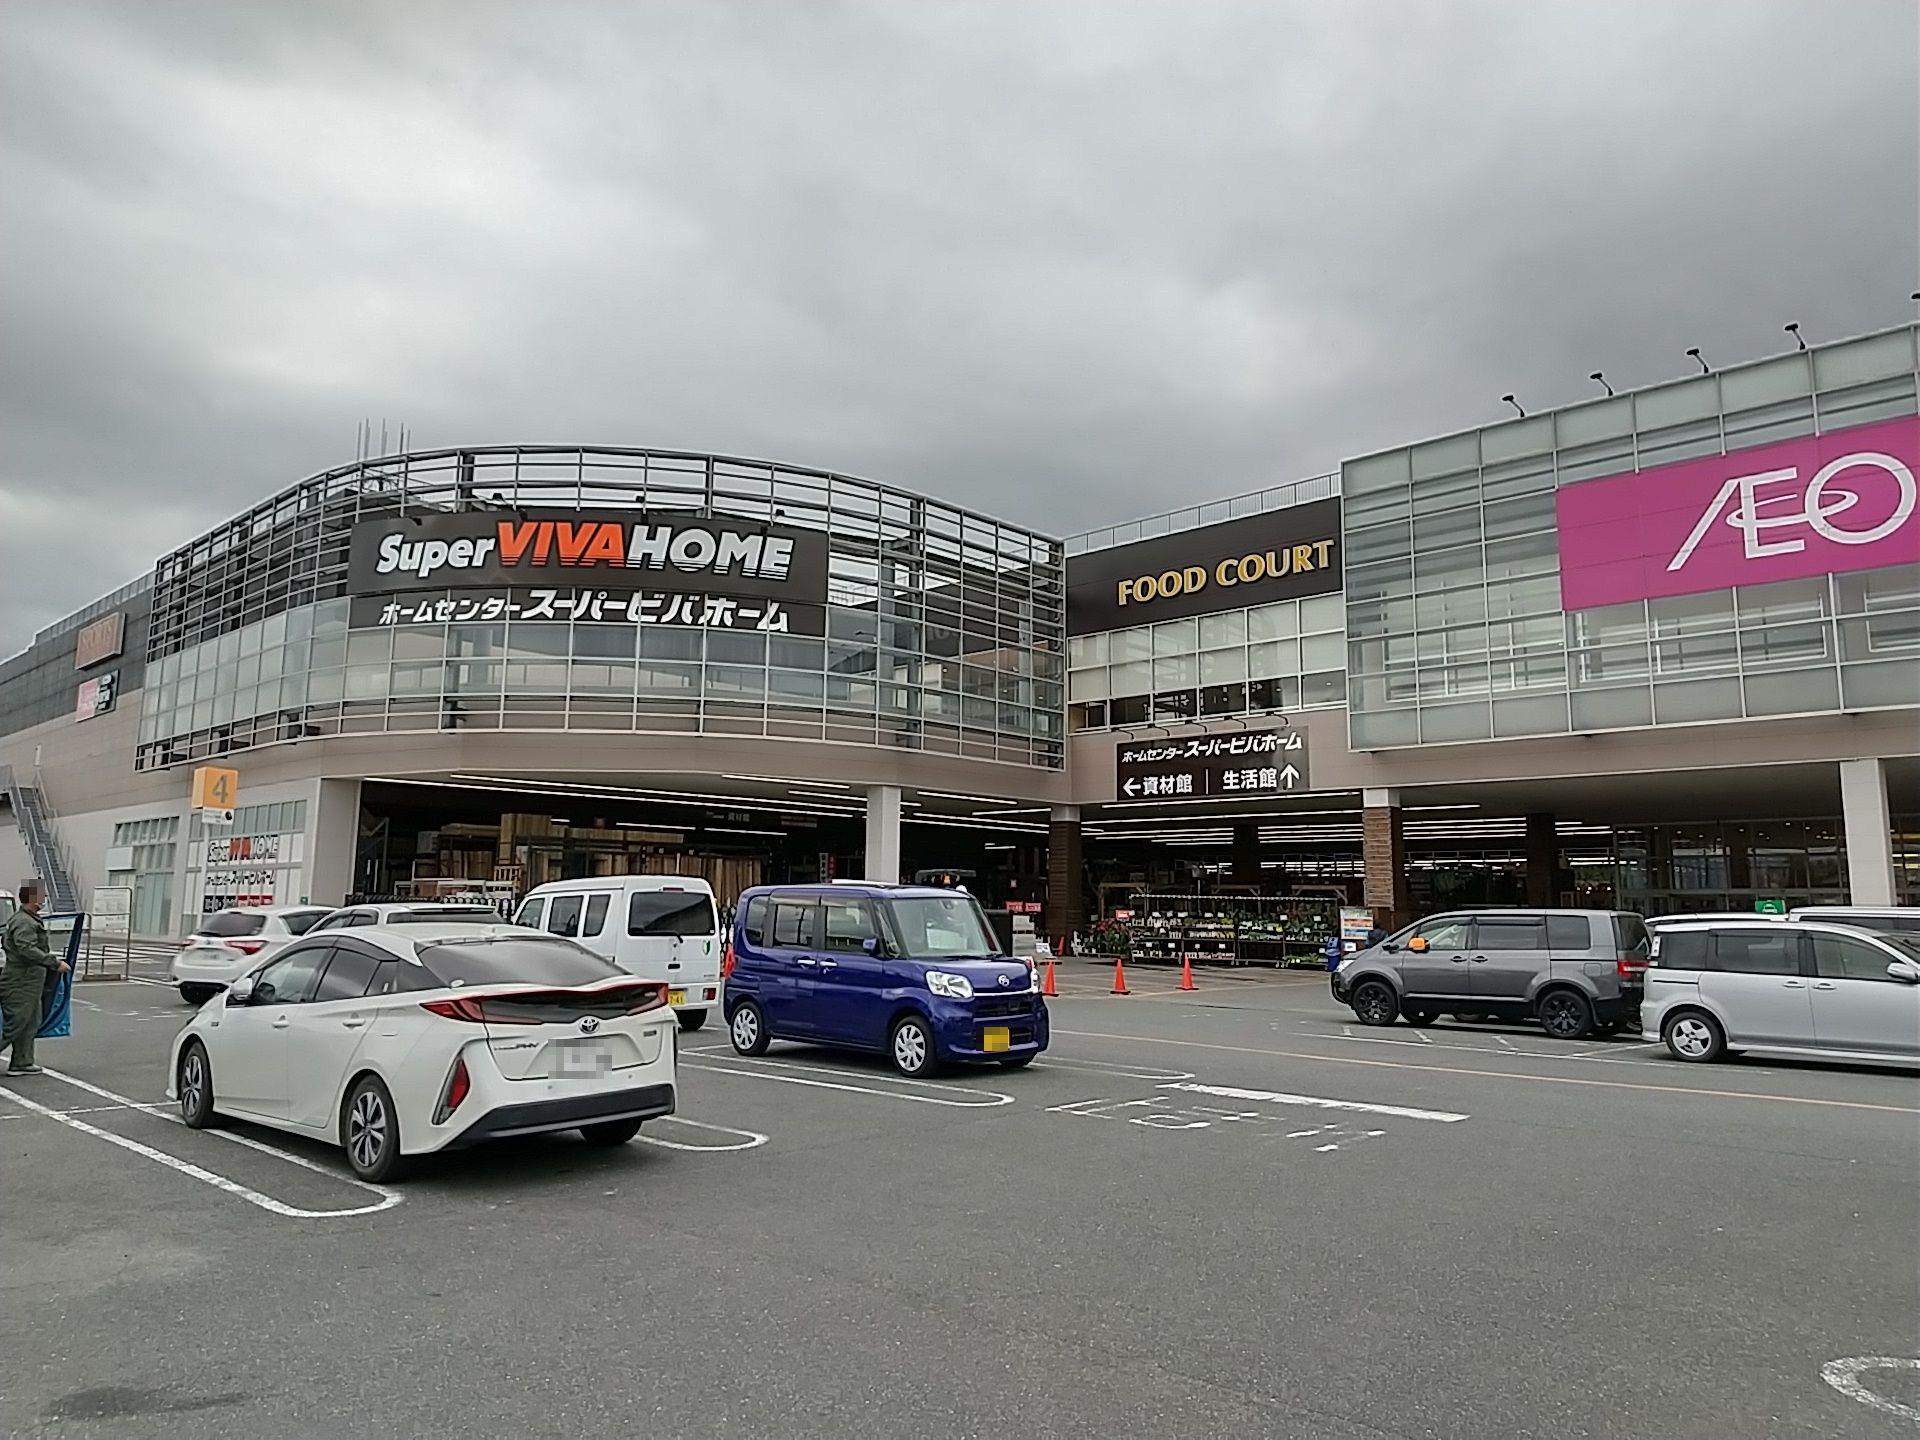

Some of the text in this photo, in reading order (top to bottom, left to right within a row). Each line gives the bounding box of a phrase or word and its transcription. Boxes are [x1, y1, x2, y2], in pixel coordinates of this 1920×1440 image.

[376, 522, 795, 581] Super VIVA HOME
[1118, 539, 1335, 606] FOOD COURT
[212, 774, 229, 803] 4
[1142, 767, 1278, 796] 資材館 生活館
